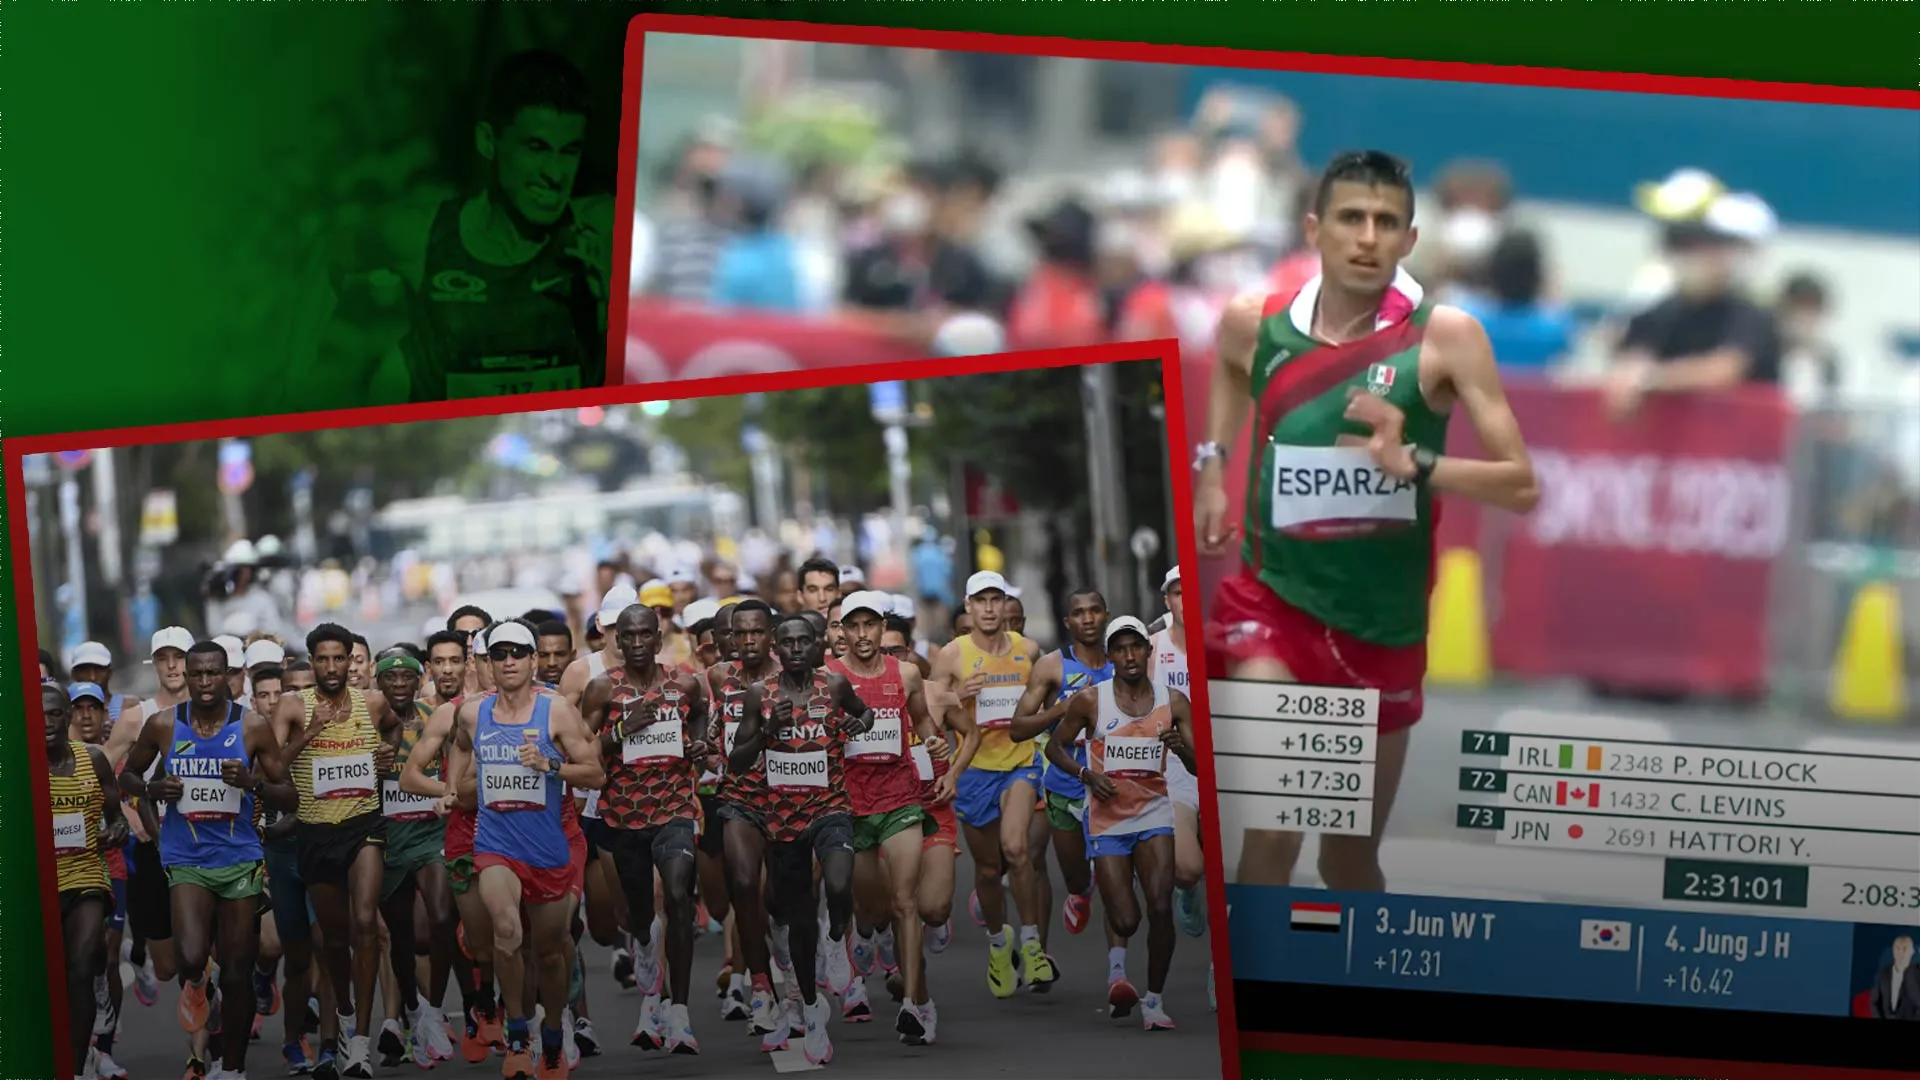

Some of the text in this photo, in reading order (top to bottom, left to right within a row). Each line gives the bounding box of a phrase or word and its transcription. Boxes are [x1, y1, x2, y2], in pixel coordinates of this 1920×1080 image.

[629, 731, 677, 746] KIPCHOGE
[773, 723, 827, 741] ENYA
[310, 737, 366, 750] GERMANY
[1106, 744, 1162, 762] NAGEEYE
[318, 762, 370, 781] PETROS
[768, 759, 825, 776] CHERONO
[486, 775, 540, 790] SUAREZ
[190, 787, 227, 802] GEAY
